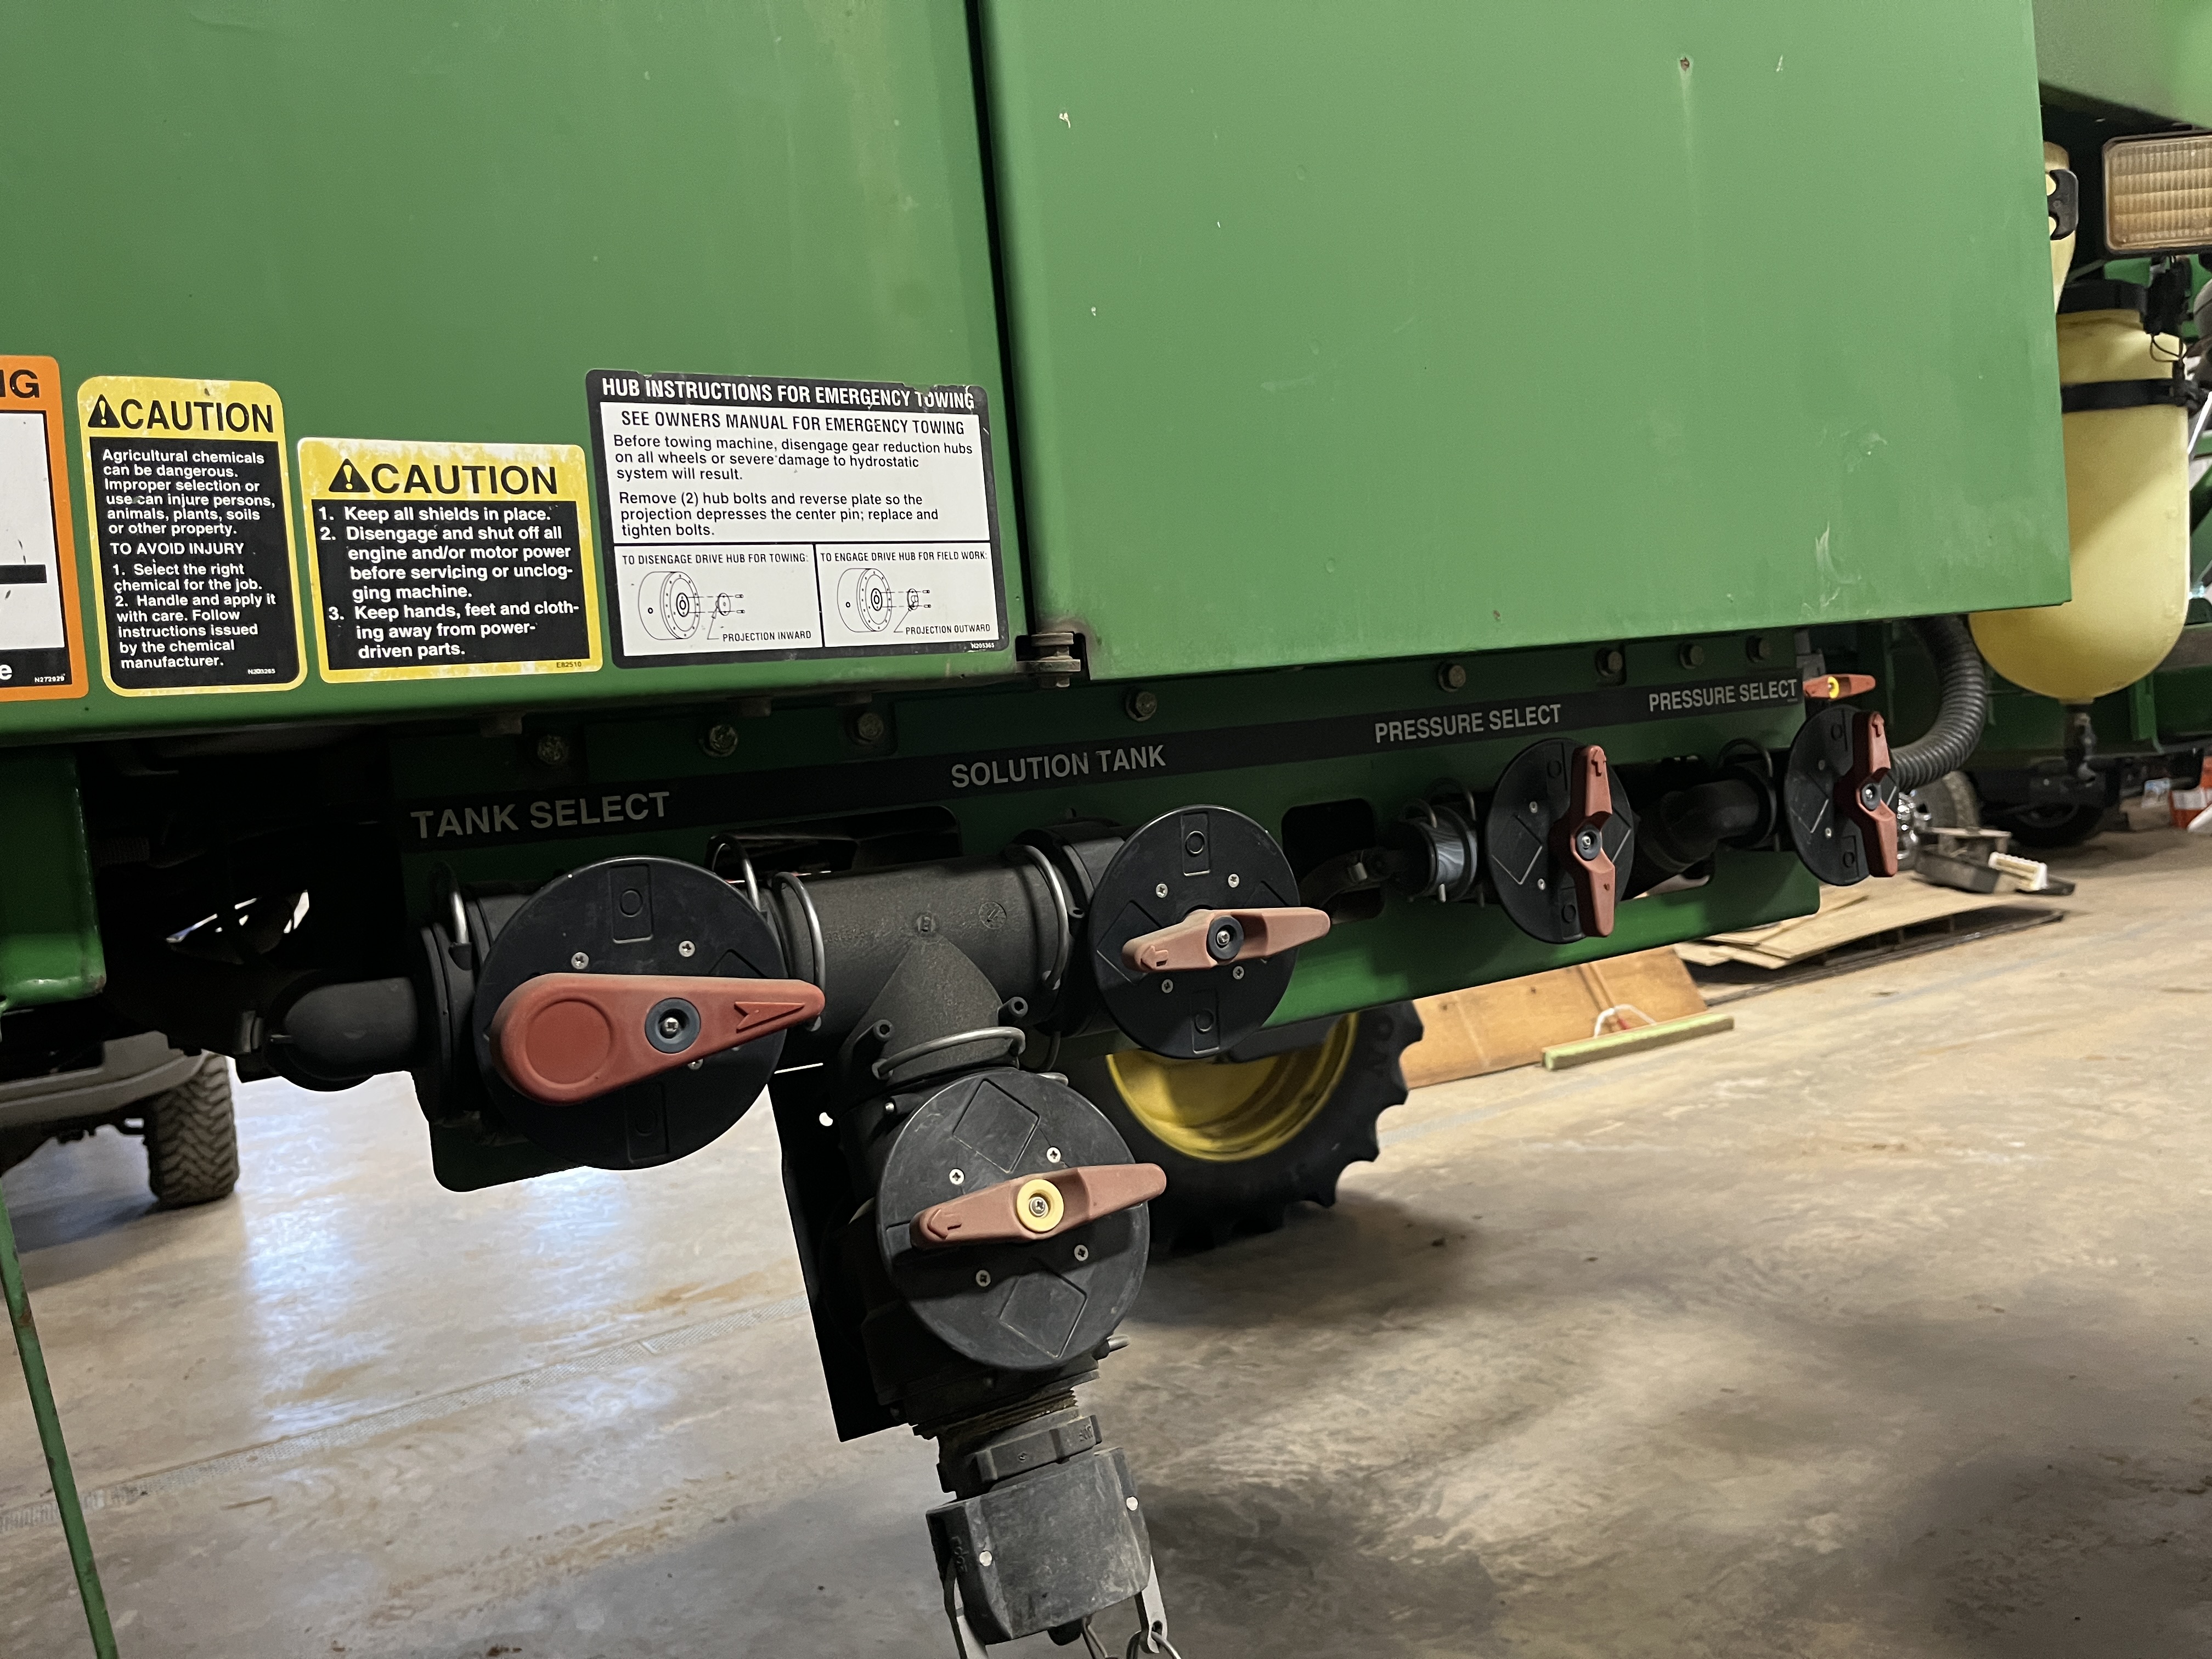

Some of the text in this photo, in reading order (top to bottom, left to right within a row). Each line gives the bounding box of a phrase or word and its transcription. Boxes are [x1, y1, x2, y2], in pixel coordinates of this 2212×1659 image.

[602, 378, 640, 396] HUB
[645, 380, 772, 402] INSTRUCTIONS
[777, 385, 810, 403] FOR
[815, 387, 910, 407] EMERGENCY
[121, 399, 273, 433] CAUTION
[622, 411, 964, 435] SEE OWNERS MANUAL FOR EMERGENCY TOWING
[614, 435, 972, 454] Before towing machine, disengage gear reduction hubs
[103, 449, 264, 464] Agricultural chemicals
[616, 451, 919, 469] on all wheels or severe damage to hydrostatic
[104, 464, 238, 479] can be dangerous.
[371, 464, 557, 494] CAUTION
[617, 467, 742, 482] system will result.
[105, 478, 259, 493] Improper selection or
[106, 493, 275, 510] use can injure persons,
[619, 492, 922, 507] Remove (2) hub bolts and reverse plate so the
[108, 507, 260, 522] animals, plants, soils
[319, 506, 551, 524] 1. Keep all shields in place.
[621, 508, 938, 523] projection depresses the center pin; replace and
[109, 522, 236, 537] or other property.
[320, 526, 562, 544] 2. Disengage and shut off all
[622, 524, 714, 539] tighten bolts.
[110, 543, 244, 555] TO AVOID INJURY
[348, 545, 571, 563] engine and/or motor power
[820, 551, 988, 561] TO ENGAGE DRIVE HUB FOR FIELD WORK:
[622, 553, 809, 565] TO DISENGAGE DRIVE HUB FOR TOWING:
[113, 563, 245, 578] 1. Select the right
[350, 563, 573, 581] before servicing or unclog-
[114, 578, 262, 592] chemical for the job.
[115, 593, 276, 608] 2. Handle and apply it
[352, 584, 472, 603] ging machine.
[116, 609, 240, 622] with care. Follow
[329, 601, 579, 622] 3. Keep hands, feet and cloth-
[118, 623, 258, 637] instructions issued
[356, 623, 535, 642] ing away from power-
[723, 631, 811, 642] PROJECTION INWARD
[906, 624, 990, 635] PROJECTION OUTWARD
[120, 639, 234, 656] by the chemical
[358, 642, 465, 659] driven parts.
[121, 656, 223, 669] manufacturer.
[1649, 679, 1797, 712] PRESSURE SELECT
[1375, 704, 1561, 743] PRESSURE SELECT
[952, 744, 1166, 787] SOLUTION TANK
[410, 792, 669, 838] TANK SELECT
